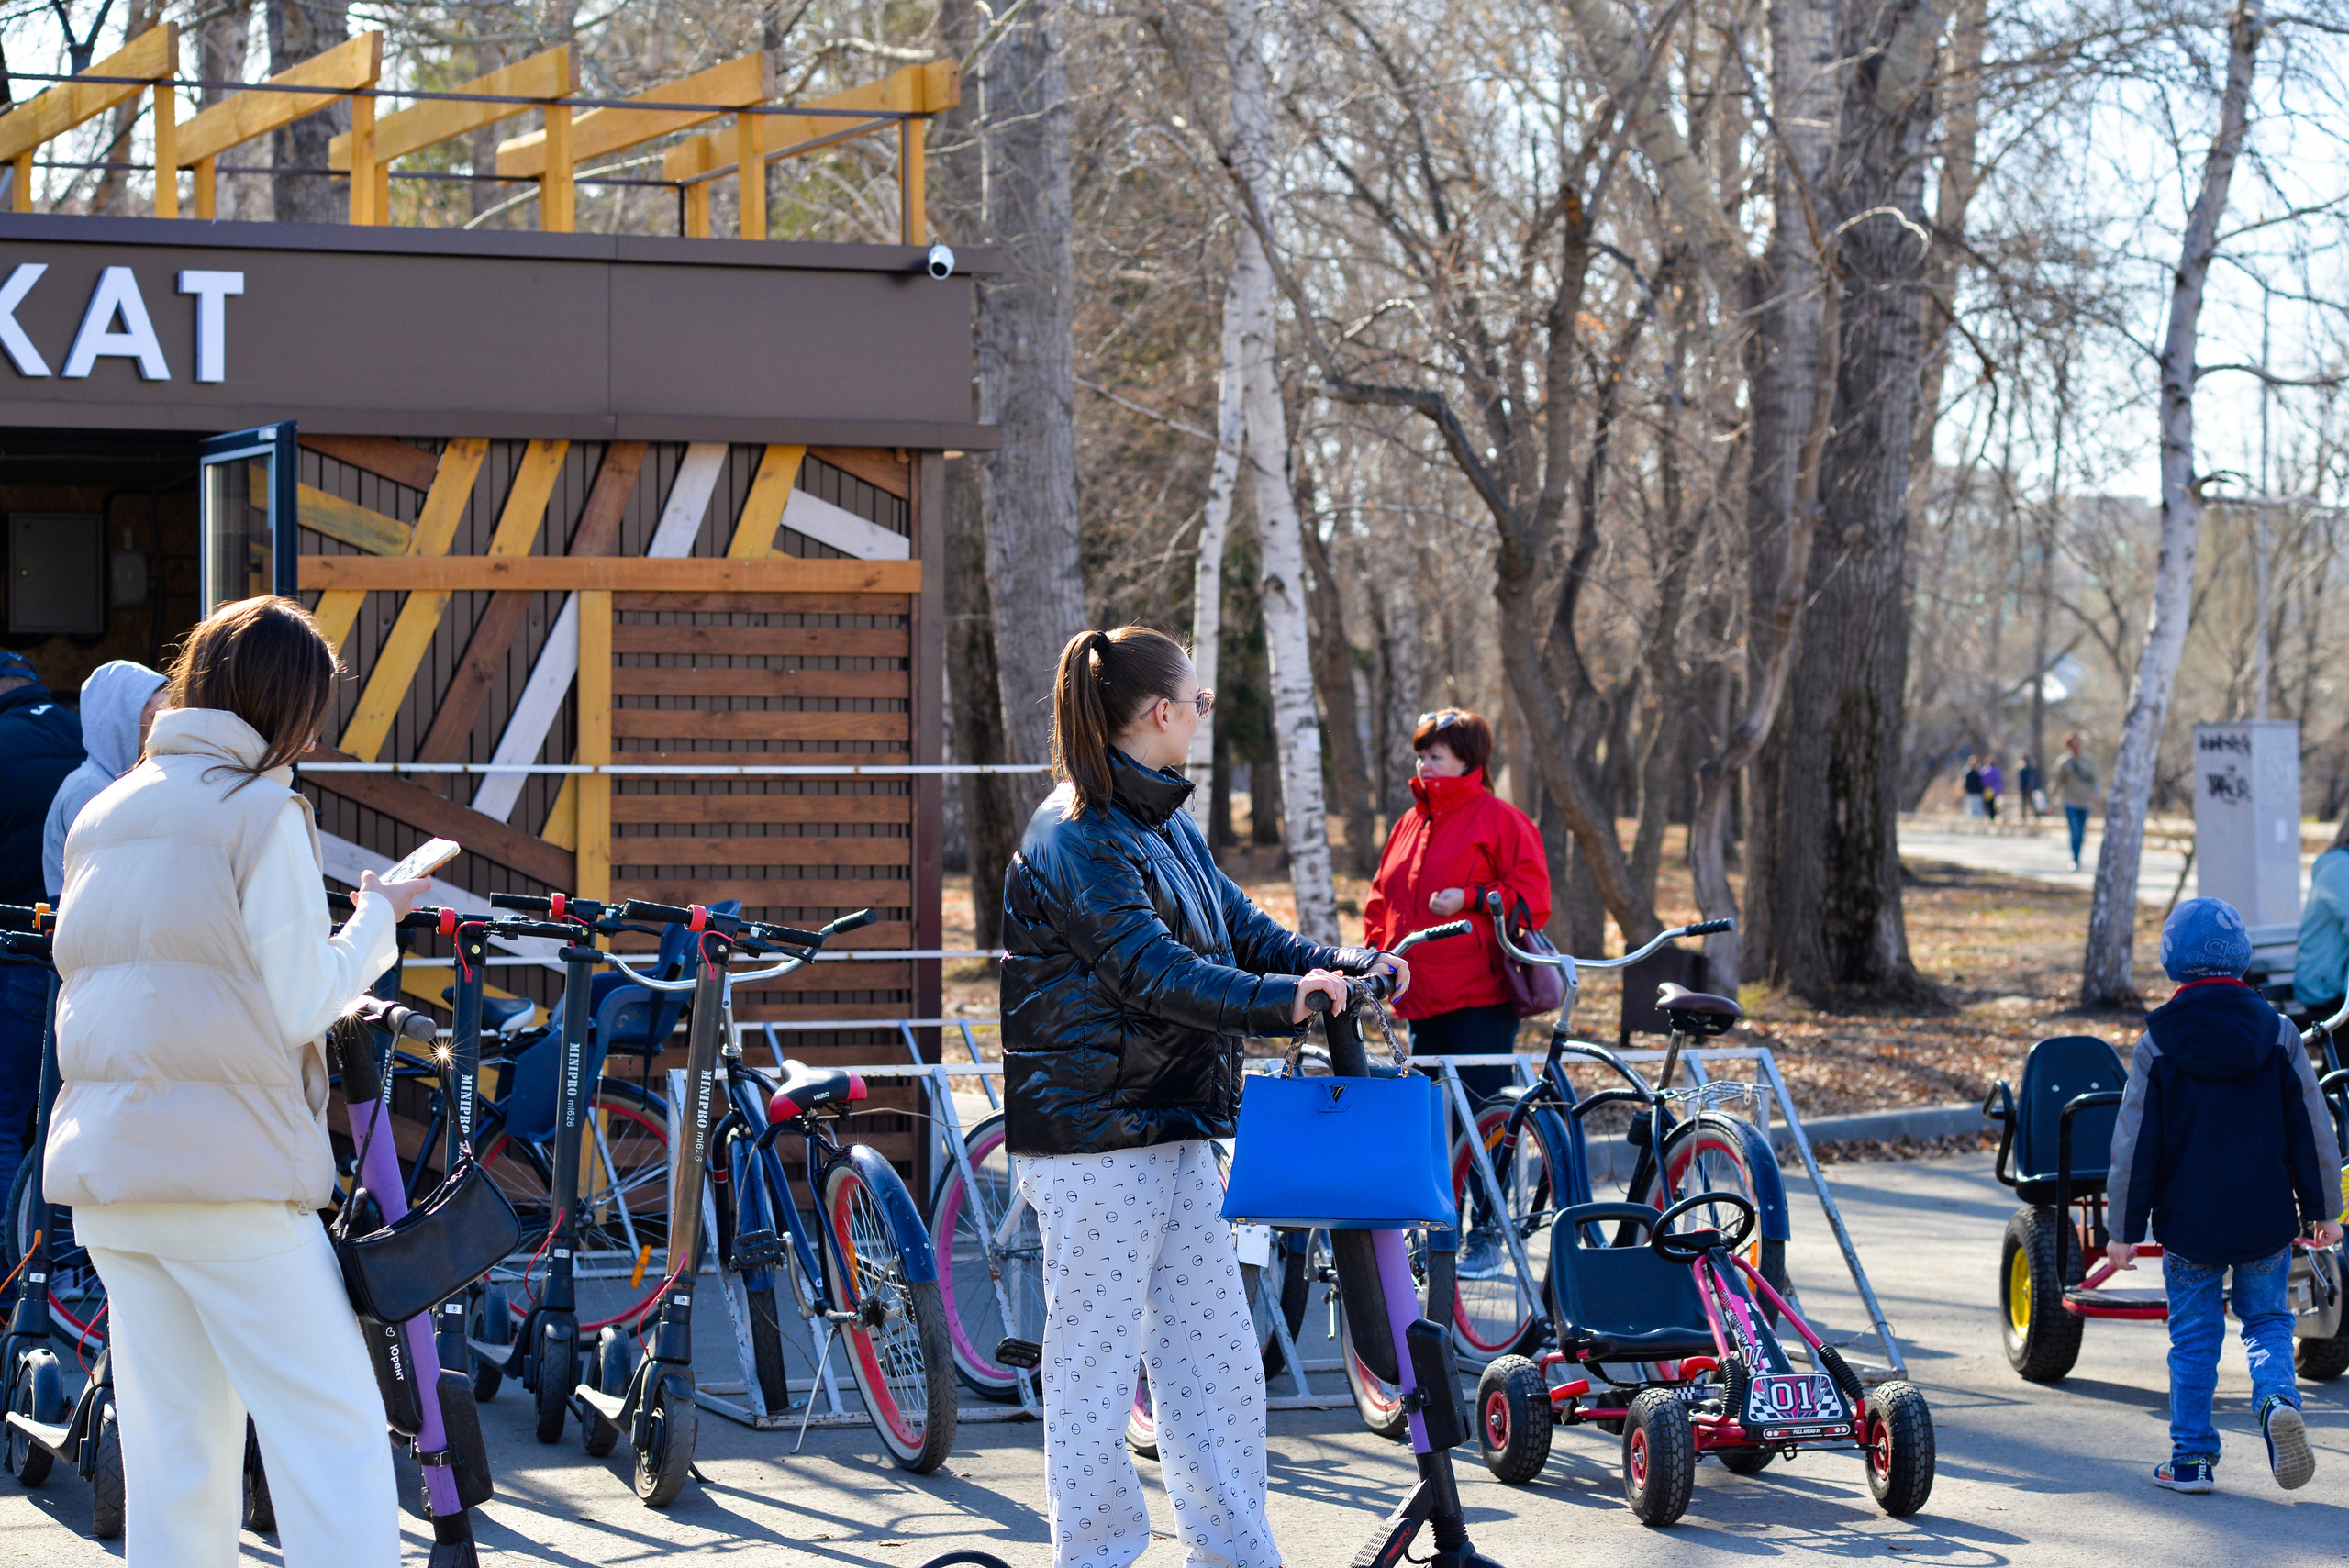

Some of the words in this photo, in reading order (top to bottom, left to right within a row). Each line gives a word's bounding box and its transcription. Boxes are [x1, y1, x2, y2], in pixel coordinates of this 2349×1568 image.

[0, 262, 245, 383] КАТ
[566, 1042, 580, 1096] MINIPRO
[460, 1073, 473, 1134] MINIPRO
[566, 1099, 575, 1128] mi626
[696, 1070, 712, 1129] MINIPRO
[813, 1091, 830, 1101] HERO
[695, 1131, 705, 1162] mi626
[1720, 1289, 1734, 1314] FULL
[1731, 1312, 1749, 1345] AHEAD
[1742, 1344, 1764, 1368] 01
[390, 1344, 404, 1381] Юрент
[1770, 1380, 1814, 1412] 01
